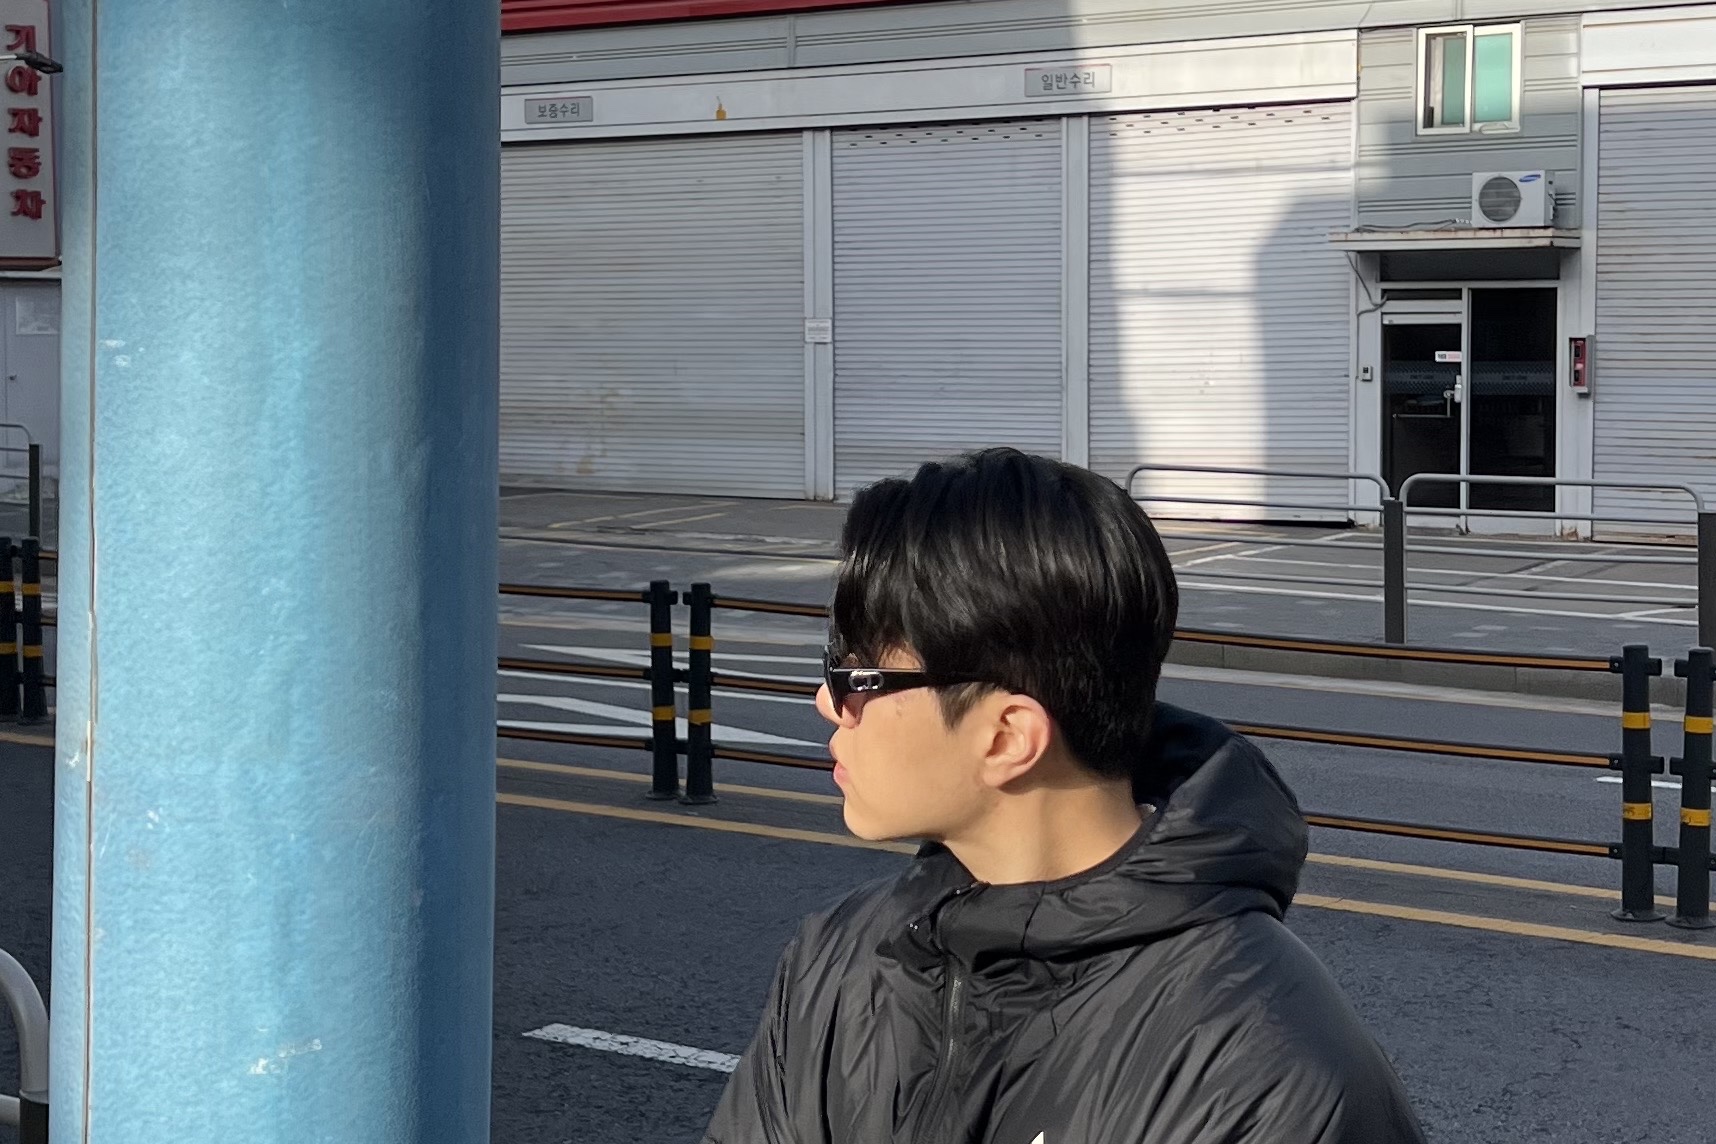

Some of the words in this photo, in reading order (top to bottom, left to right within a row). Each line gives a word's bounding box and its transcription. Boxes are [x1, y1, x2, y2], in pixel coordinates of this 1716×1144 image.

[1041, 71, 1096, 91] 일반수리
[537, 102, 580, 119] 보증수리
[5, 24, 46, 221] 기아자동차
